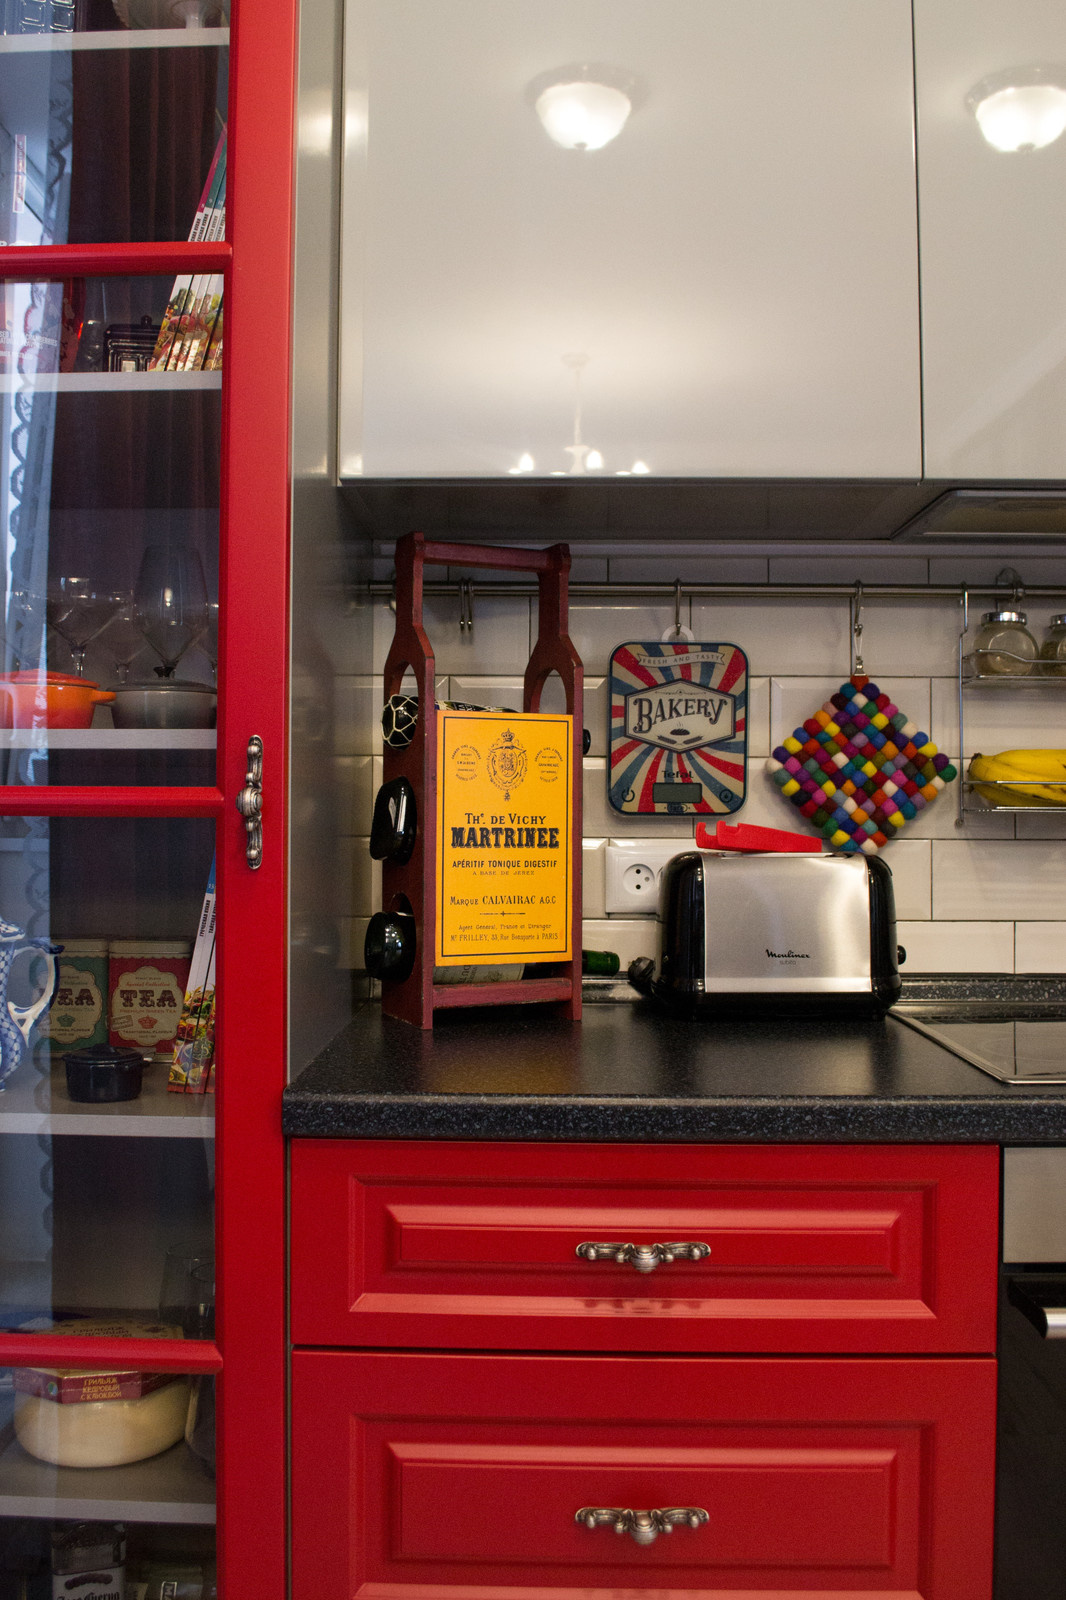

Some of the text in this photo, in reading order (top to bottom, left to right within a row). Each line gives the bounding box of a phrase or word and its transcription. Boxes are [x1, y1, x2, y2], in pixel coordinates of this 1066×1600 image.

[632, 698, 728, 734] BAKERY
[662, 770, 694, 778] Tefal
[451, 827, 560, 848] MARTRINEE
[452, 859, 558, 868] APÉRITIF TONIQUE DIGESTIF
[482, 895, 536, 905] CALVAIRAC
[766, 948, 810, 958] Moulinex
[120, 990, 177, 1007] TEA
[84, 1377, 117, 1385] ГРИЛЬЯЖ
[82, 1384, 120, 1393] КЕДРОВЫЙ
[87, 1392, 121, 1400] КЛЮКВОЙ
